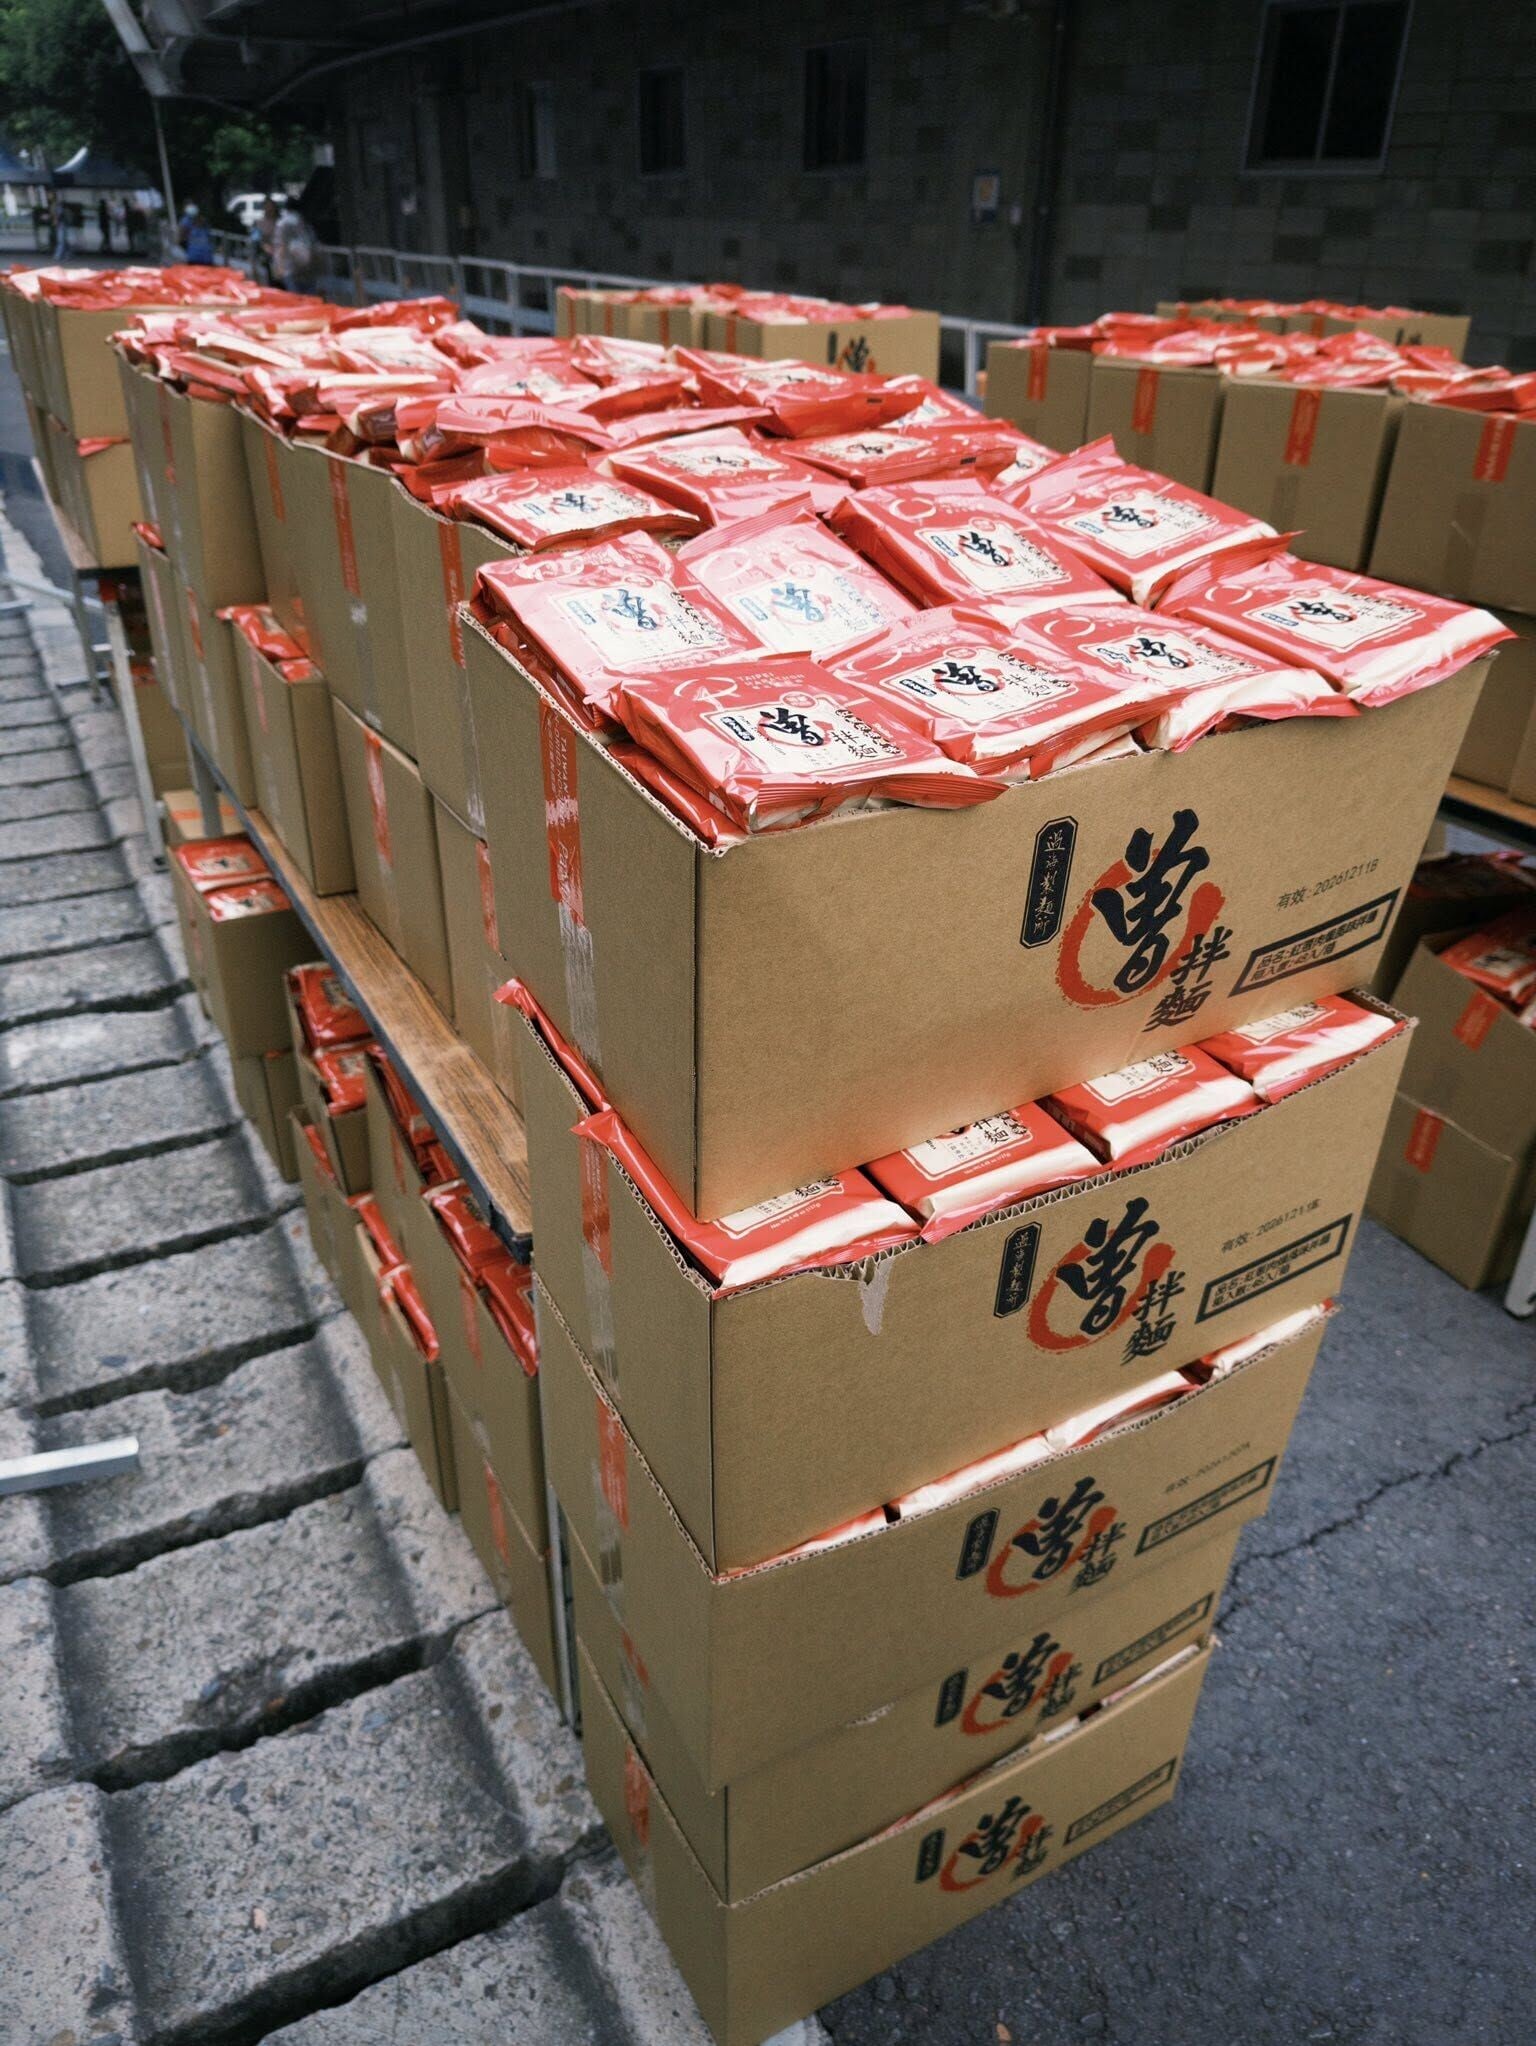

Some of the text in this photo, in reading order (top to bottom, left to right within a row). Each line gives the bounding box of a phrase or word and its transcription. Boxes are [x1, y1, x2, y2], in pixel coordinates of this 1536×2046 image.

[561, 737, 569, 794] TAIWAN
[1142, 927, 1233, 1032] 拌麵
[1120, 1270, 1186, 1366] 拌麵
